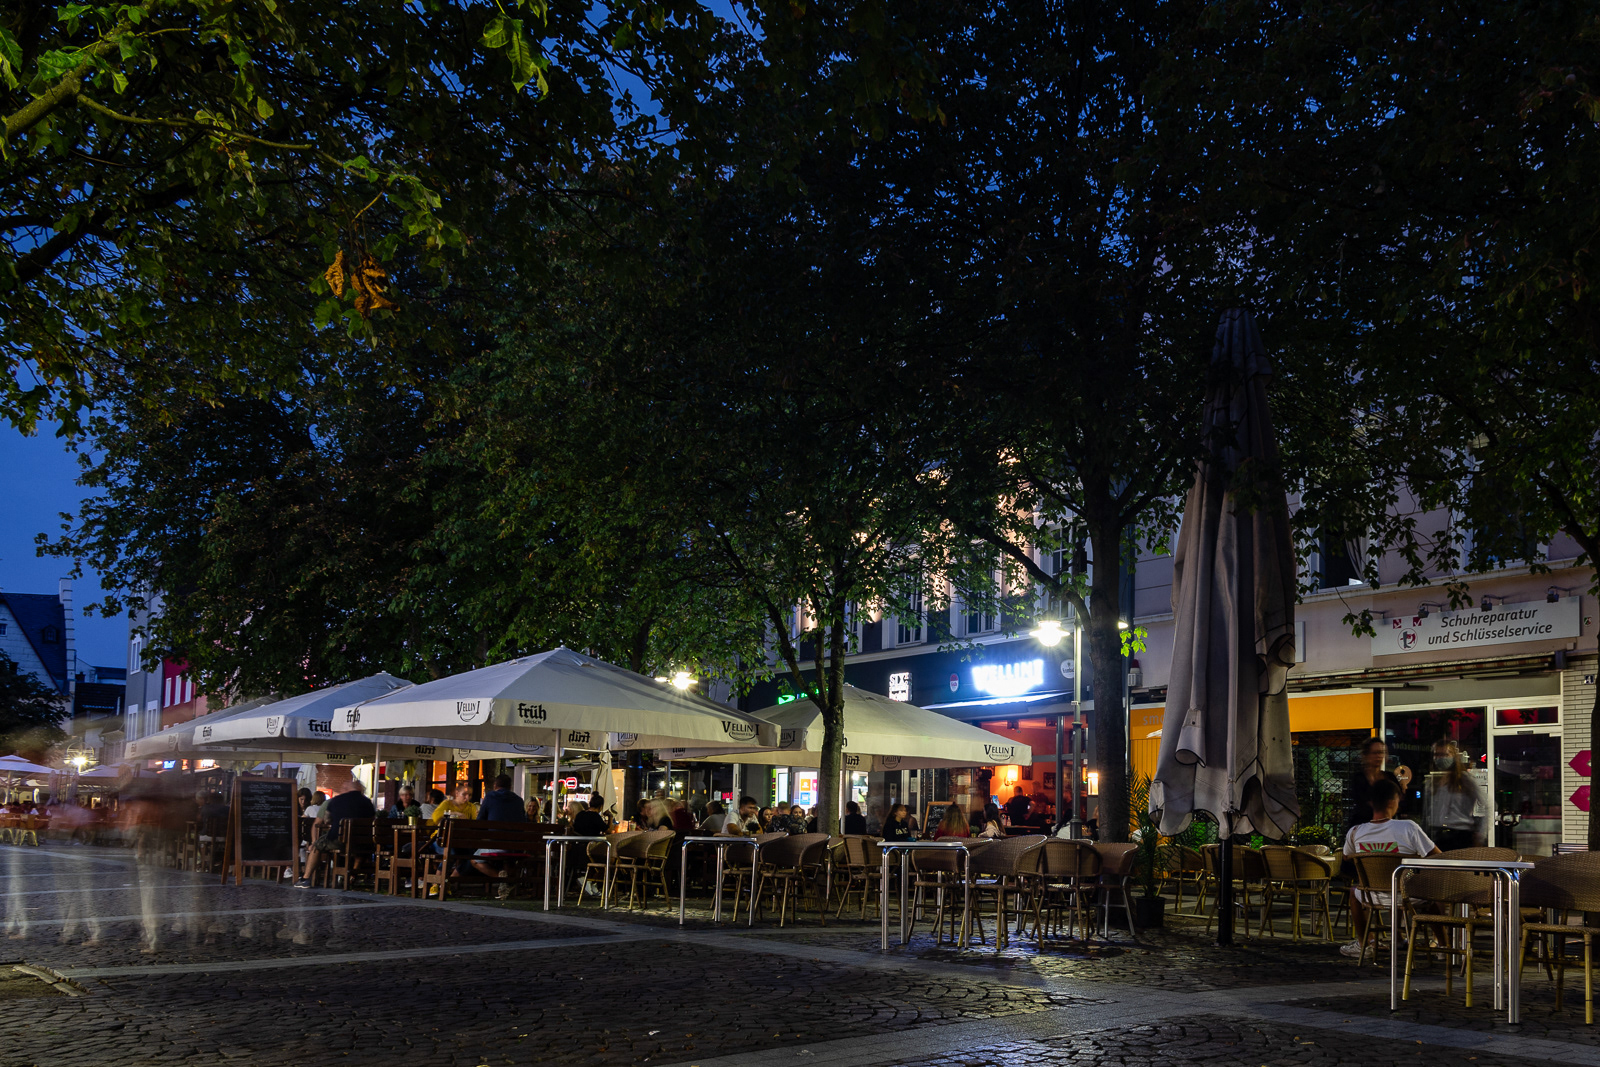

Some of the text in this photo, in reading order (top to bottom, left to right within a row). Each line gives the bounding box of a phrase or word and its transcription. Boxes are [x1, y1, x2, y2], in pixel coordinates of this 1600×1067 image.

[1441, 608, 1538, 629] Schuhreparatur
[1428, 622, 1553, 645] und Schlüsselservice
[517, 702, 547, 721] früh
[721, 720, 760, 736] VELLINI
[984, 744, 1015, 757] VELLINI
